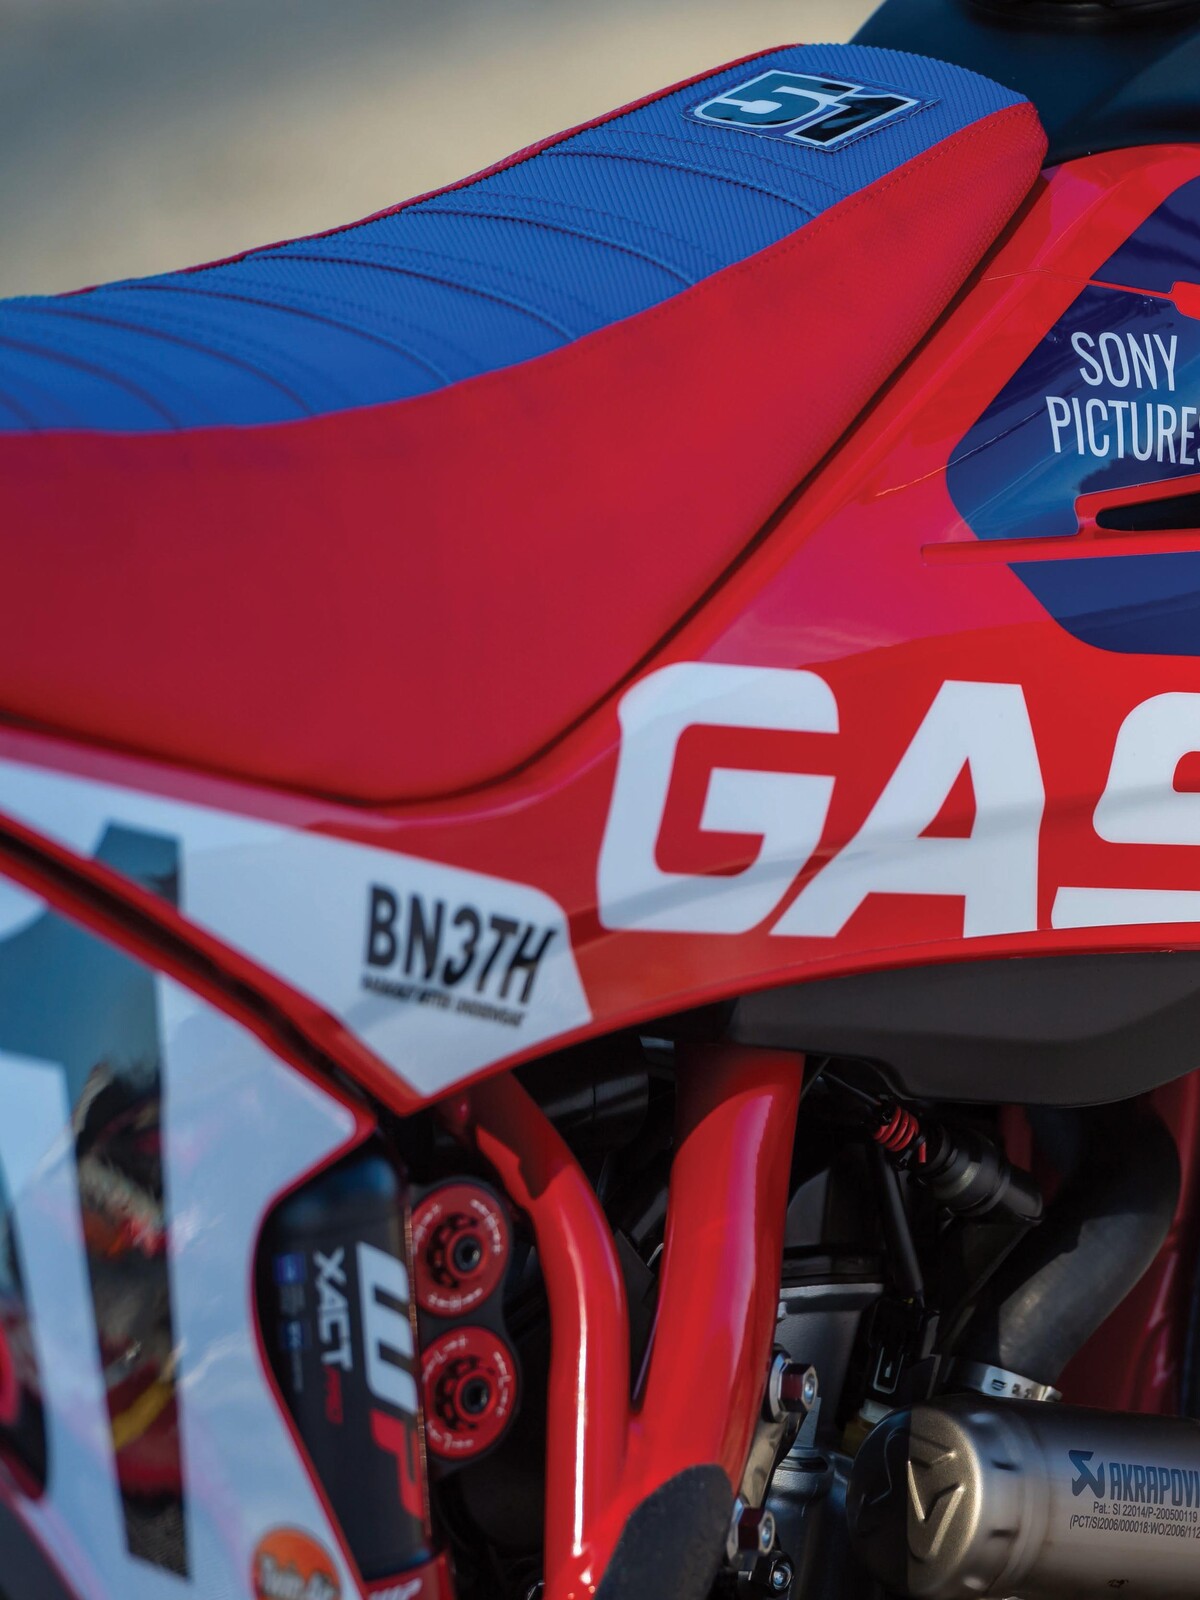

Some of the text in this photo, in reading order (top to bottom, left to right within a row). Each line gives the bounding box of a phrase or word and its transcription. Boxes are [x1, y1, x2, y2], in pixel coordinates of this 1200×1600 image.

[693, 69, 920, 147] 51
[1070, 331, 1178, 392] SONY
[366, 883, 557, 1005] BN3TH
[313, 1246, 353, 1371] XACT
[1093, 1501, 1111, 1516] Pat.:
